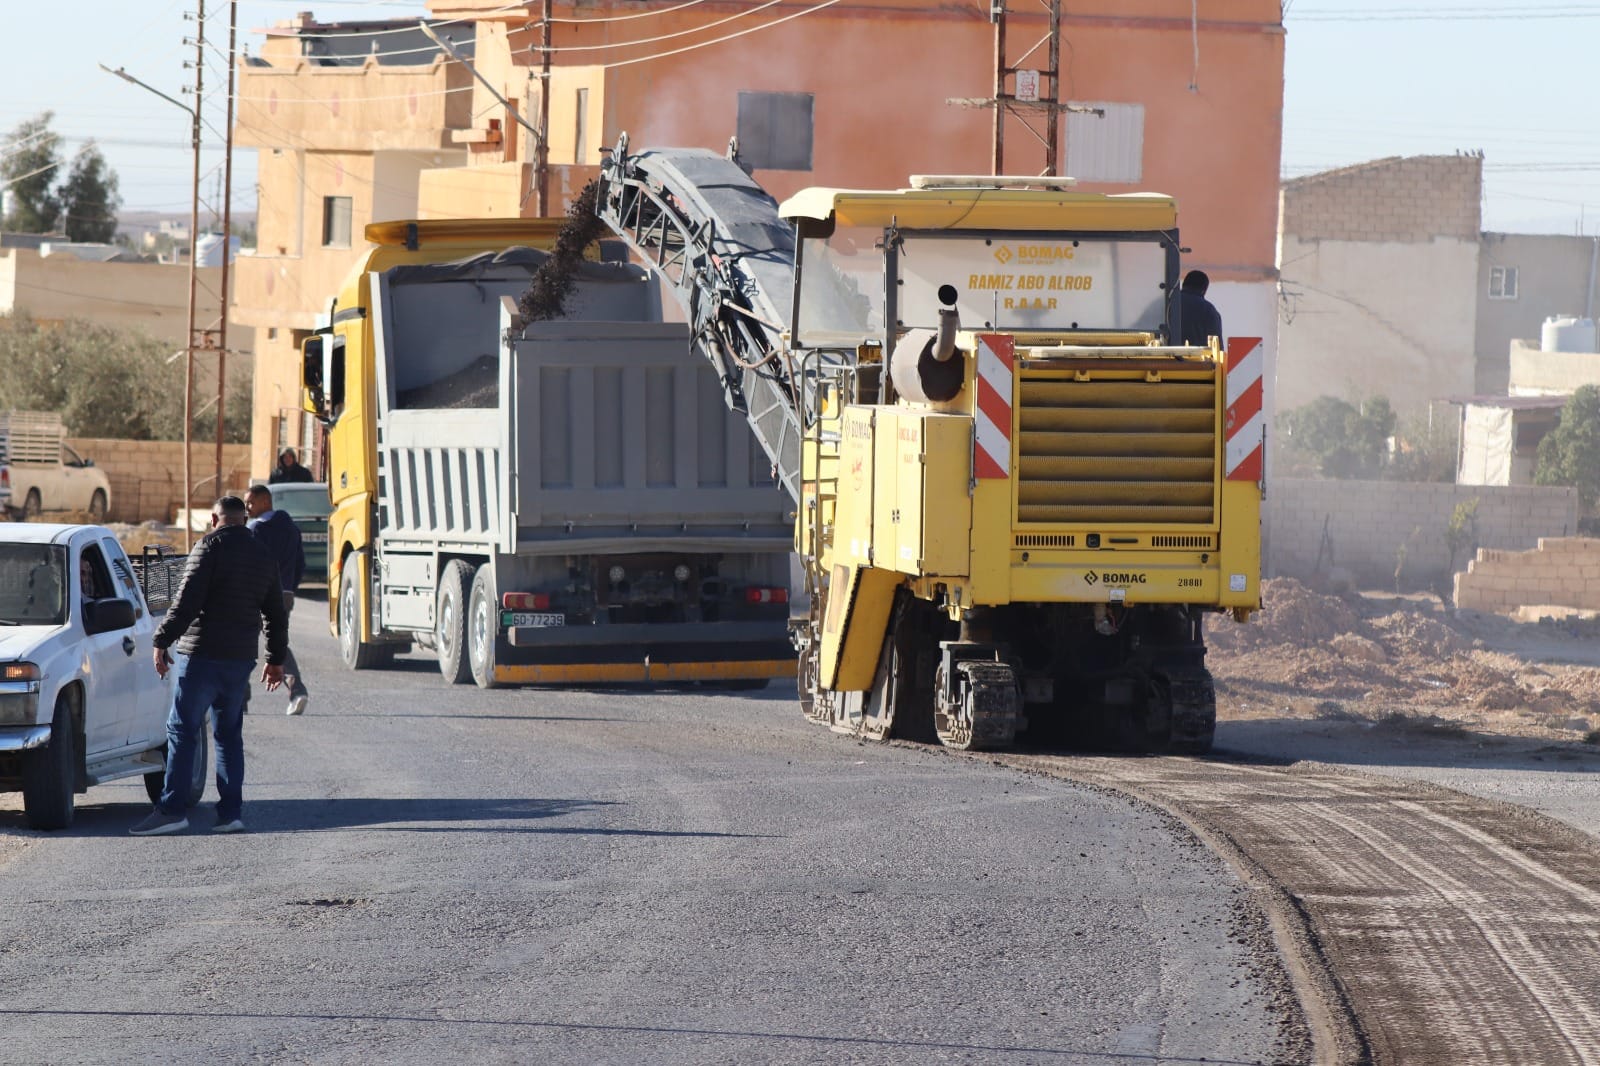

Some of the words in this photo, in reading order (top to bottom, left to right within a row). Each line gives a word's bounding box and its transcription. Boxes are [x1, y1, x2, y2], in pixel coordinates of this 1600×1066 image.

[1018, 245, 1073, 259] BOMAG
[968, 274, 1013, 290] RAMIZ
[1017, 275, 1044, 290] ABO
[1047, 275, 1092, 291] ALROB
[1102, 573, 1147, 584] BOMAG
